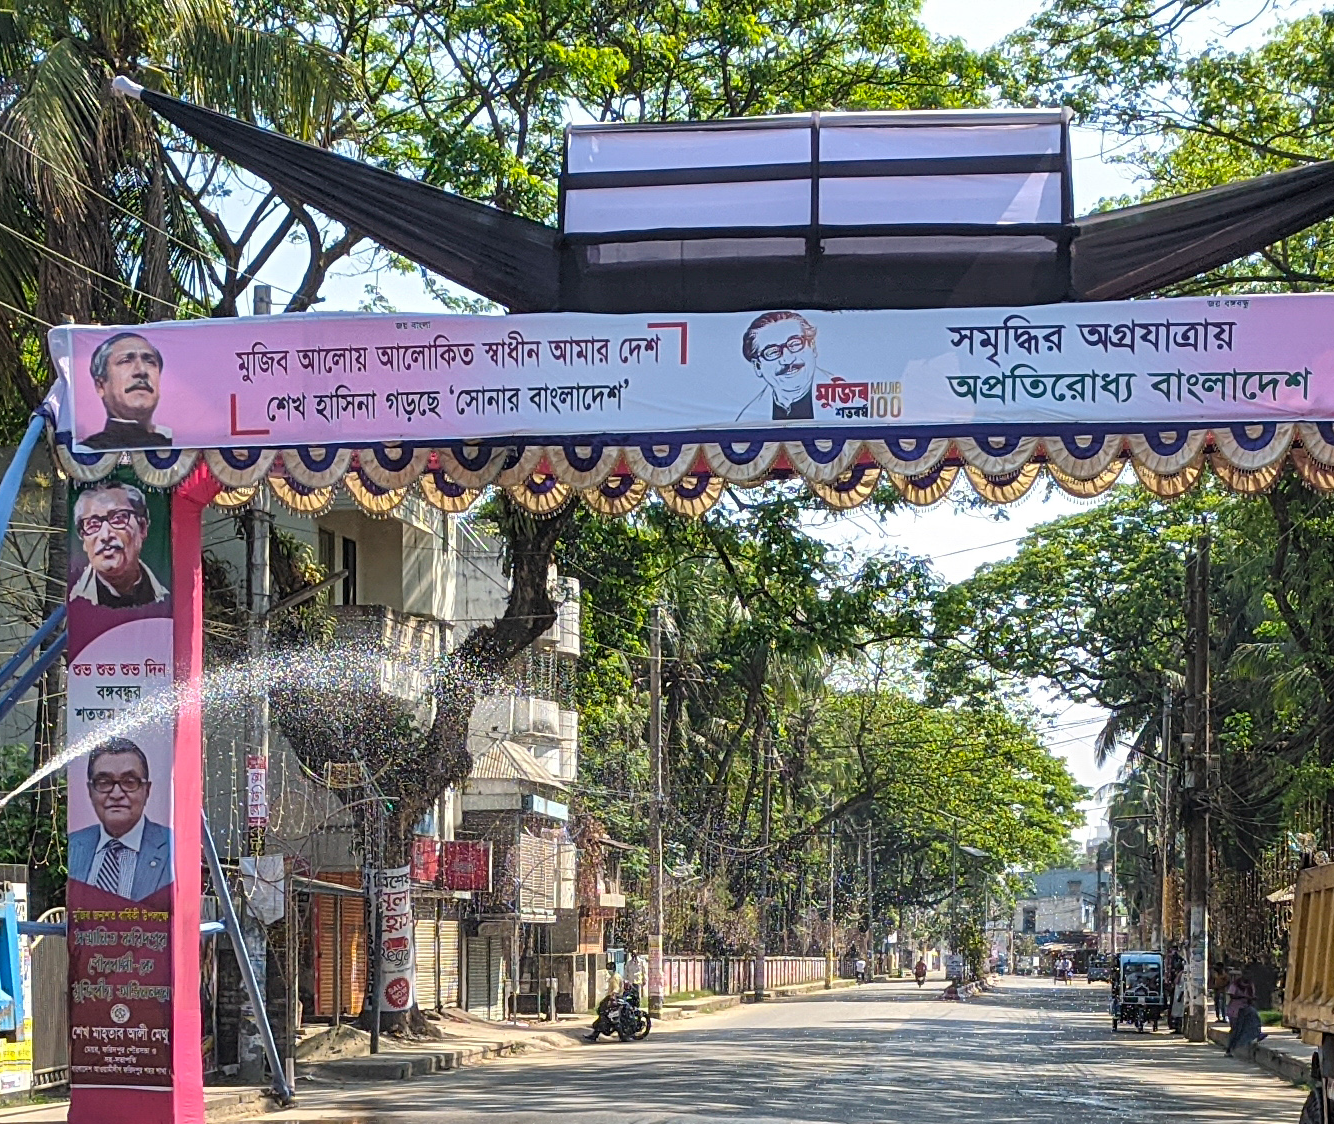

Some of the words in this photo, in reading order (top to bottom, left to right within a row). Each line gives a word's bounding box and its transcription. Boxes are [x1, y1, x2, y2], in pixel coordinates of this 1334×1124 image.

[946, 315, 1066, 367] সমৃদ্ধির
[1077, 318, 1237, 354] অগ্রযাত্রায়
[235, 342, 289, 383] মুজিব
[296, 345, 368, 375] আলোয়
[375, 334, 476, 372] আলোকিত
[482, 330, 542, 368] স্বাধীন
[547, 336, 610, 366] আমার
[619, 333, 661, 364] দেশ
[870, 381, 903, 396] MUJIB
[946, 363, 1137, 404] অপ্রতিরোধ্য
[1147, 366, 1313, 403] বাংলাদেশ
[267, 391, 306, 422] শেখ
[313, 385, 377, 424] হাসিনা
[385, 389, 442, 422] গড়ছে
[870, 395, 903, 419] 100
[73, 663, 92, 677] শুভ
[96, 663, 116, 677] শুভ
[119, 663, 141, 677] শুভ
[144, 658, 166, 677] দিন
[96, 685, 142, 702] বঙ্গবন্ধুর
[74, 707, 115, 722] শততম
[71, 1026, 89, 1039] শেখ
